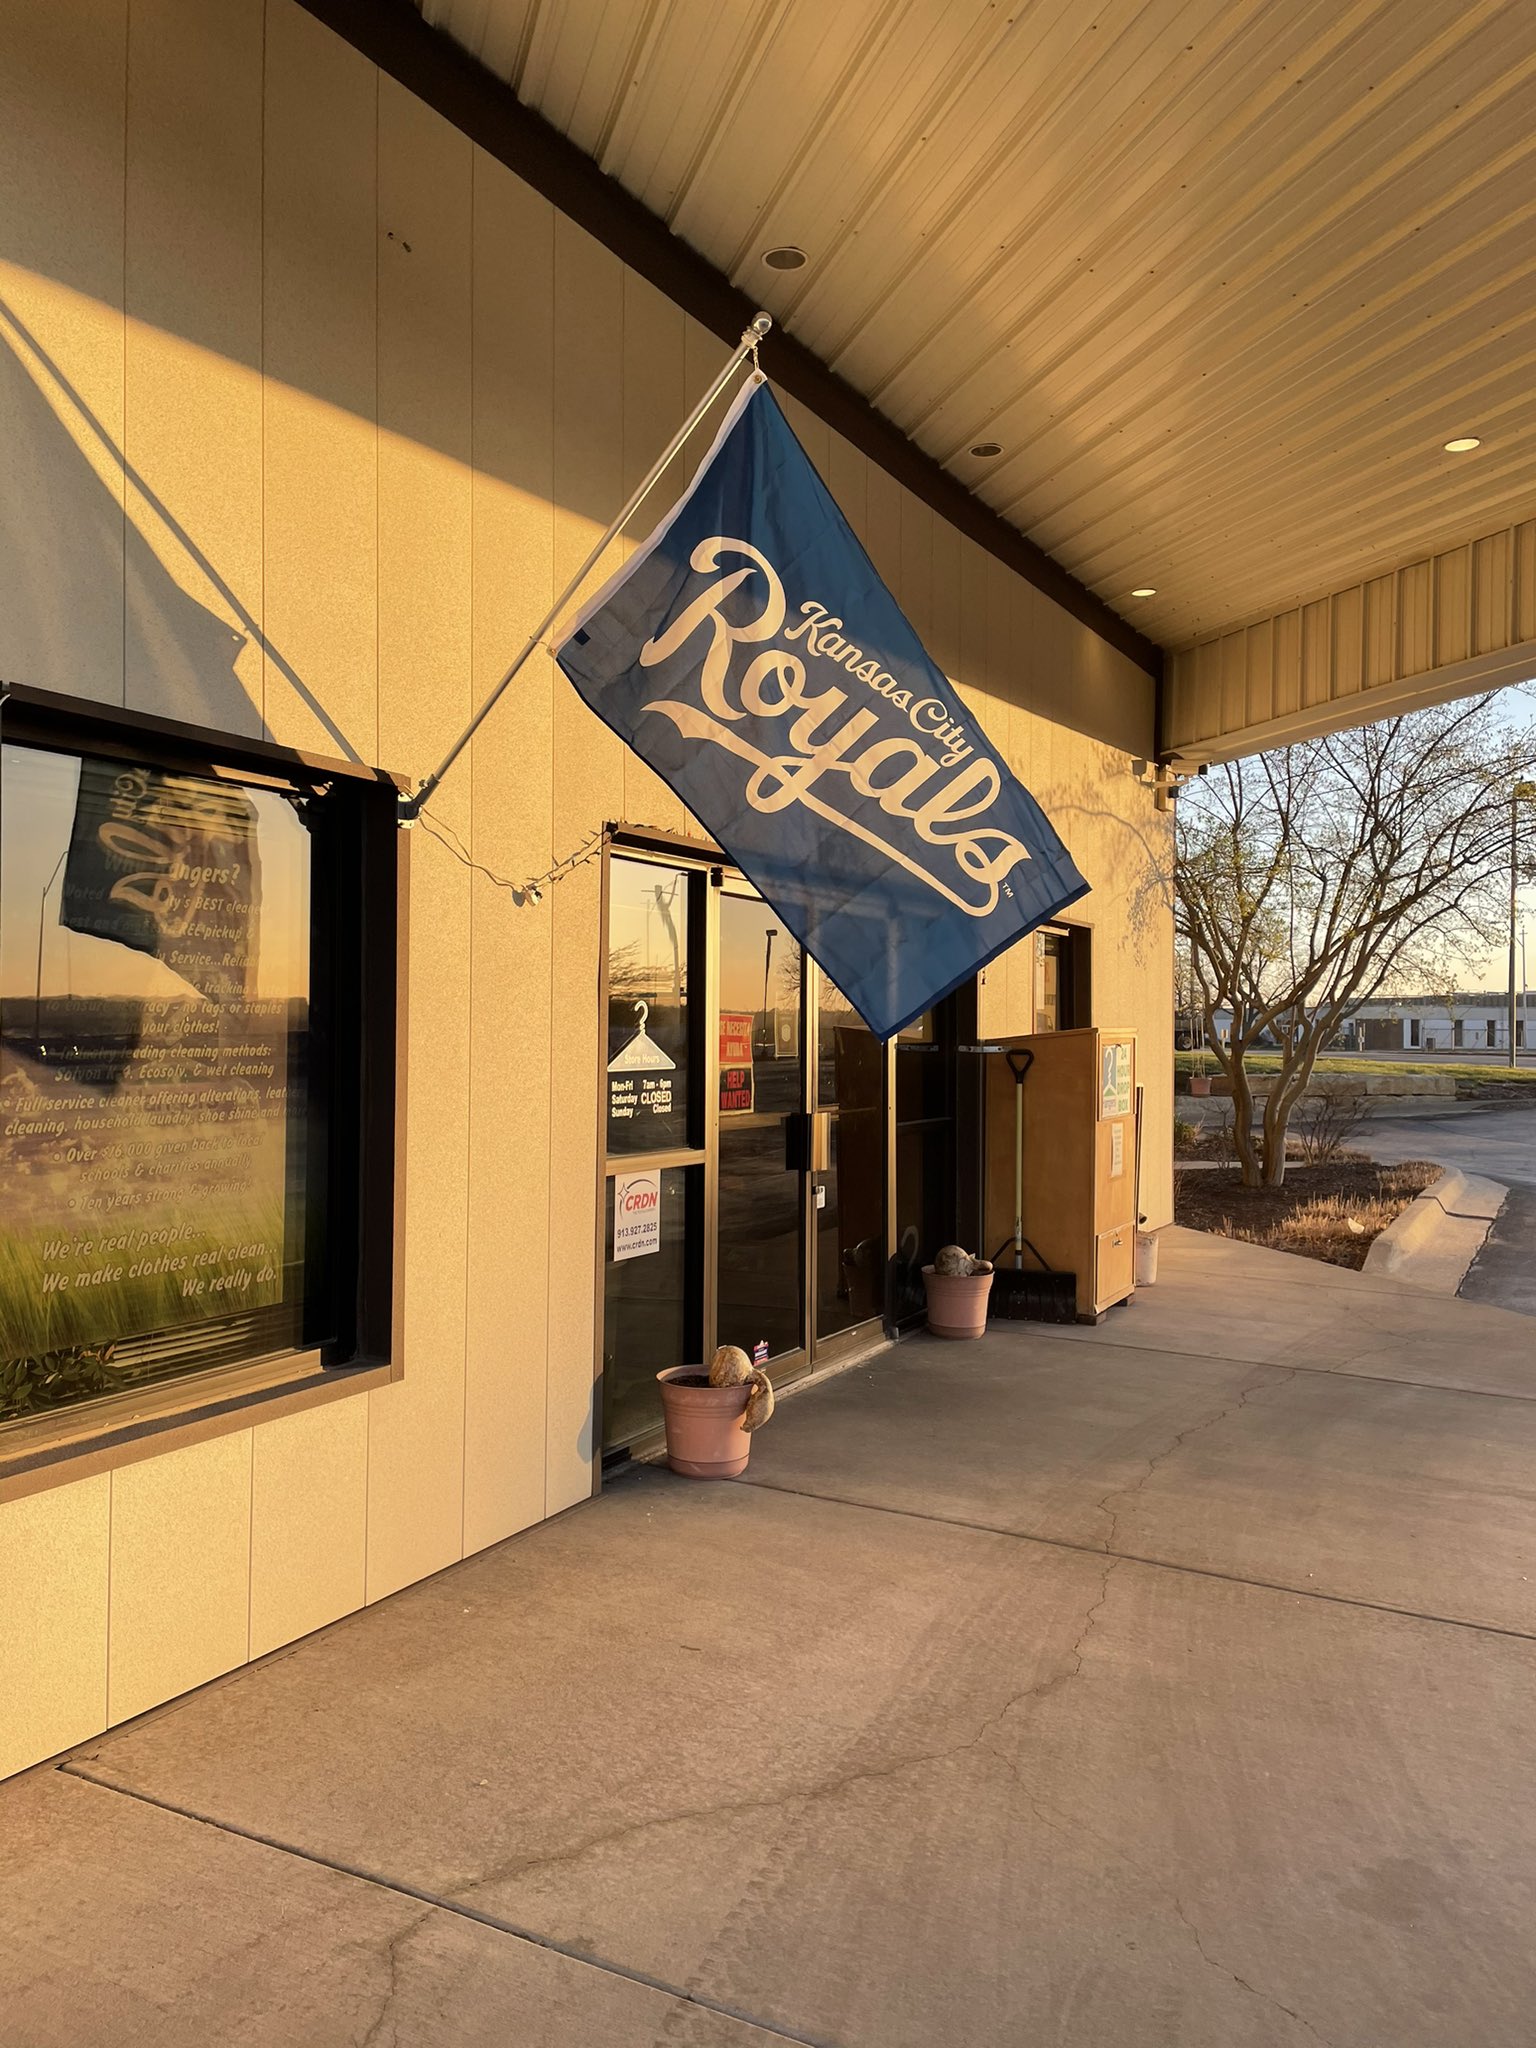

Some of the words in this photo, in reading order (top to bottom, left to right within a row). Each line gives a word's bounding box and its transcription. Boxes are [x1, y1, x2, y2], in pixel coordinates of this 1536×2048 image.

[784, 601, 913, 713] Kansas
[910, 698, 975, 767] City
[639, 536, 1032, 916] Royals
[195, 896, 225, 911] BEST
[203, 923, 242, 944] pickup
[204, 979, 249, 996] tracking
[182, 1000, 198, 1013] no
[201, 1000, 227, 1018] tags
[229, 1001, 241, 1013] or
[244, 1000, 284, 1017] staples
[142, 1020, 171, 1037] your
[173, 1018, 220, 1035] clothes!
[170, 1043, 219, 1062] cleaning
[221, 1043, 272, 1059] methods:
[624, 1052, 641, 1066] Store
[642, 1052, 661, 1065] Hours
[193, 1062, 203, 1078] &
[205, 1062, 228, 1077] wet
[230, 1060, 275, 1080] cleaning
[726, 1070, 745, 1089] HELP
[611, 1079, 634, 1092] Mon-Fri
[642, 1079, 656, 1090] 7am
[1116, 1080, 1130, 1096] DROP
[98, 1094, 146, 1110] cleaner
[149, 1090, 196, 1108] offering
[611, 1093, 638, 1105] Saturday
[640, 1090, 672, 1105] CLOSED
[720, 1090, 750, 1109] WANTED
[1117, 1098, 1129, 1112] BOX
[74, 1114, 141, 1131] household
[199, 1108, 226, 1122] shoe
[260, 1104, 283, 1119] and
[611, 1105, 634, 1119] Sunday
[652, 1102, 672, 1114] Closed
[66, 1147, 98, 1162] Over
[154, 1139, 189, 1158] given
[191, 1134, 219, 1150] back
[80, 1164, 131, 1183] schools
[134, 1161, 145, 1178] &
[149, 1157, 201, 1177] charities
[203, 1152, 253, 1171] annually
[81, 1196, 103, 1211] Ten
[107, 1193, 142, 1213] years
[146, 1187, 185, 1203] strong
[625, 1191, 658, 1212] CRDN
[616, 1221, 658, 1239] 913.927.2825
[42, 1236, 92, 1261] We're
[98, 1229, 135, 1252] real
[137, 1222, 207, 1252] people...
[616, 1237, 658, 1253] www.crdn.com
[42, 1271, 69, 1293] We
[75, 1262, 123, 1288] make
[128, 1253, 188, 1279] clothes
[192, 1244, 223, 1267] real
[228, 1240, 278, 1261] clean...
[182, 1278, 206, 1297] We
[209, 1268, 253, 1292] really
[256, 1263, 278, 1284] do.
